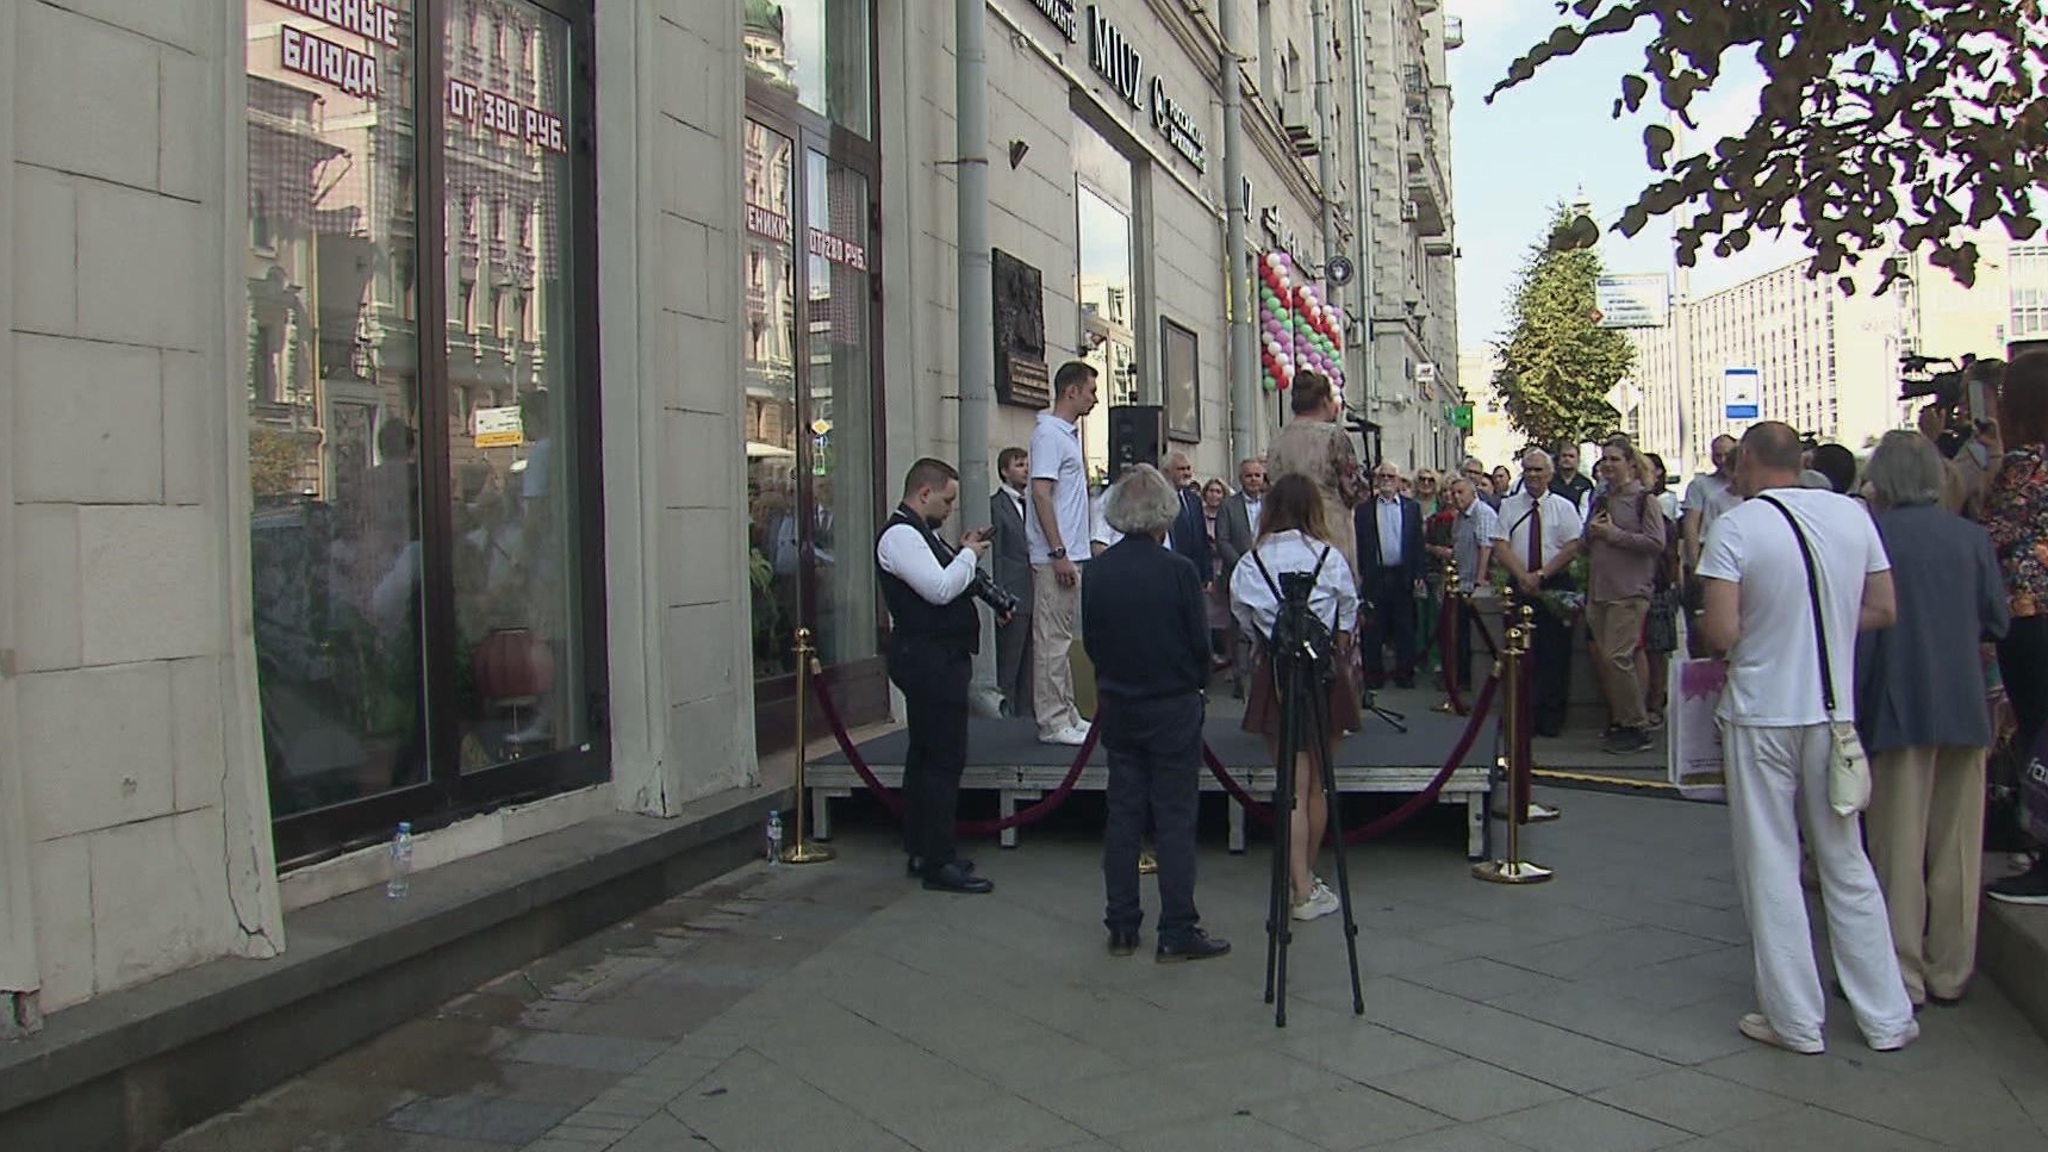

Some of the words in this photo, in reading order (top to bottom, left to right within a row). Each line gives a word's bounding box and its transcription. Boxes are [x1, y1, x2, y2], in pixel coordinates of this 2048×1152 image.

[283, 28, 376, 95] БЛЮДА
[1092, 4, 1143, 111] MIUZ
[451, 80, 477, 120] ОТ
[483, 92, 518, 136] 390
[526, 109, 567, 153] РУБ.
[746, 205, 787, 242] ЕНИКИ
